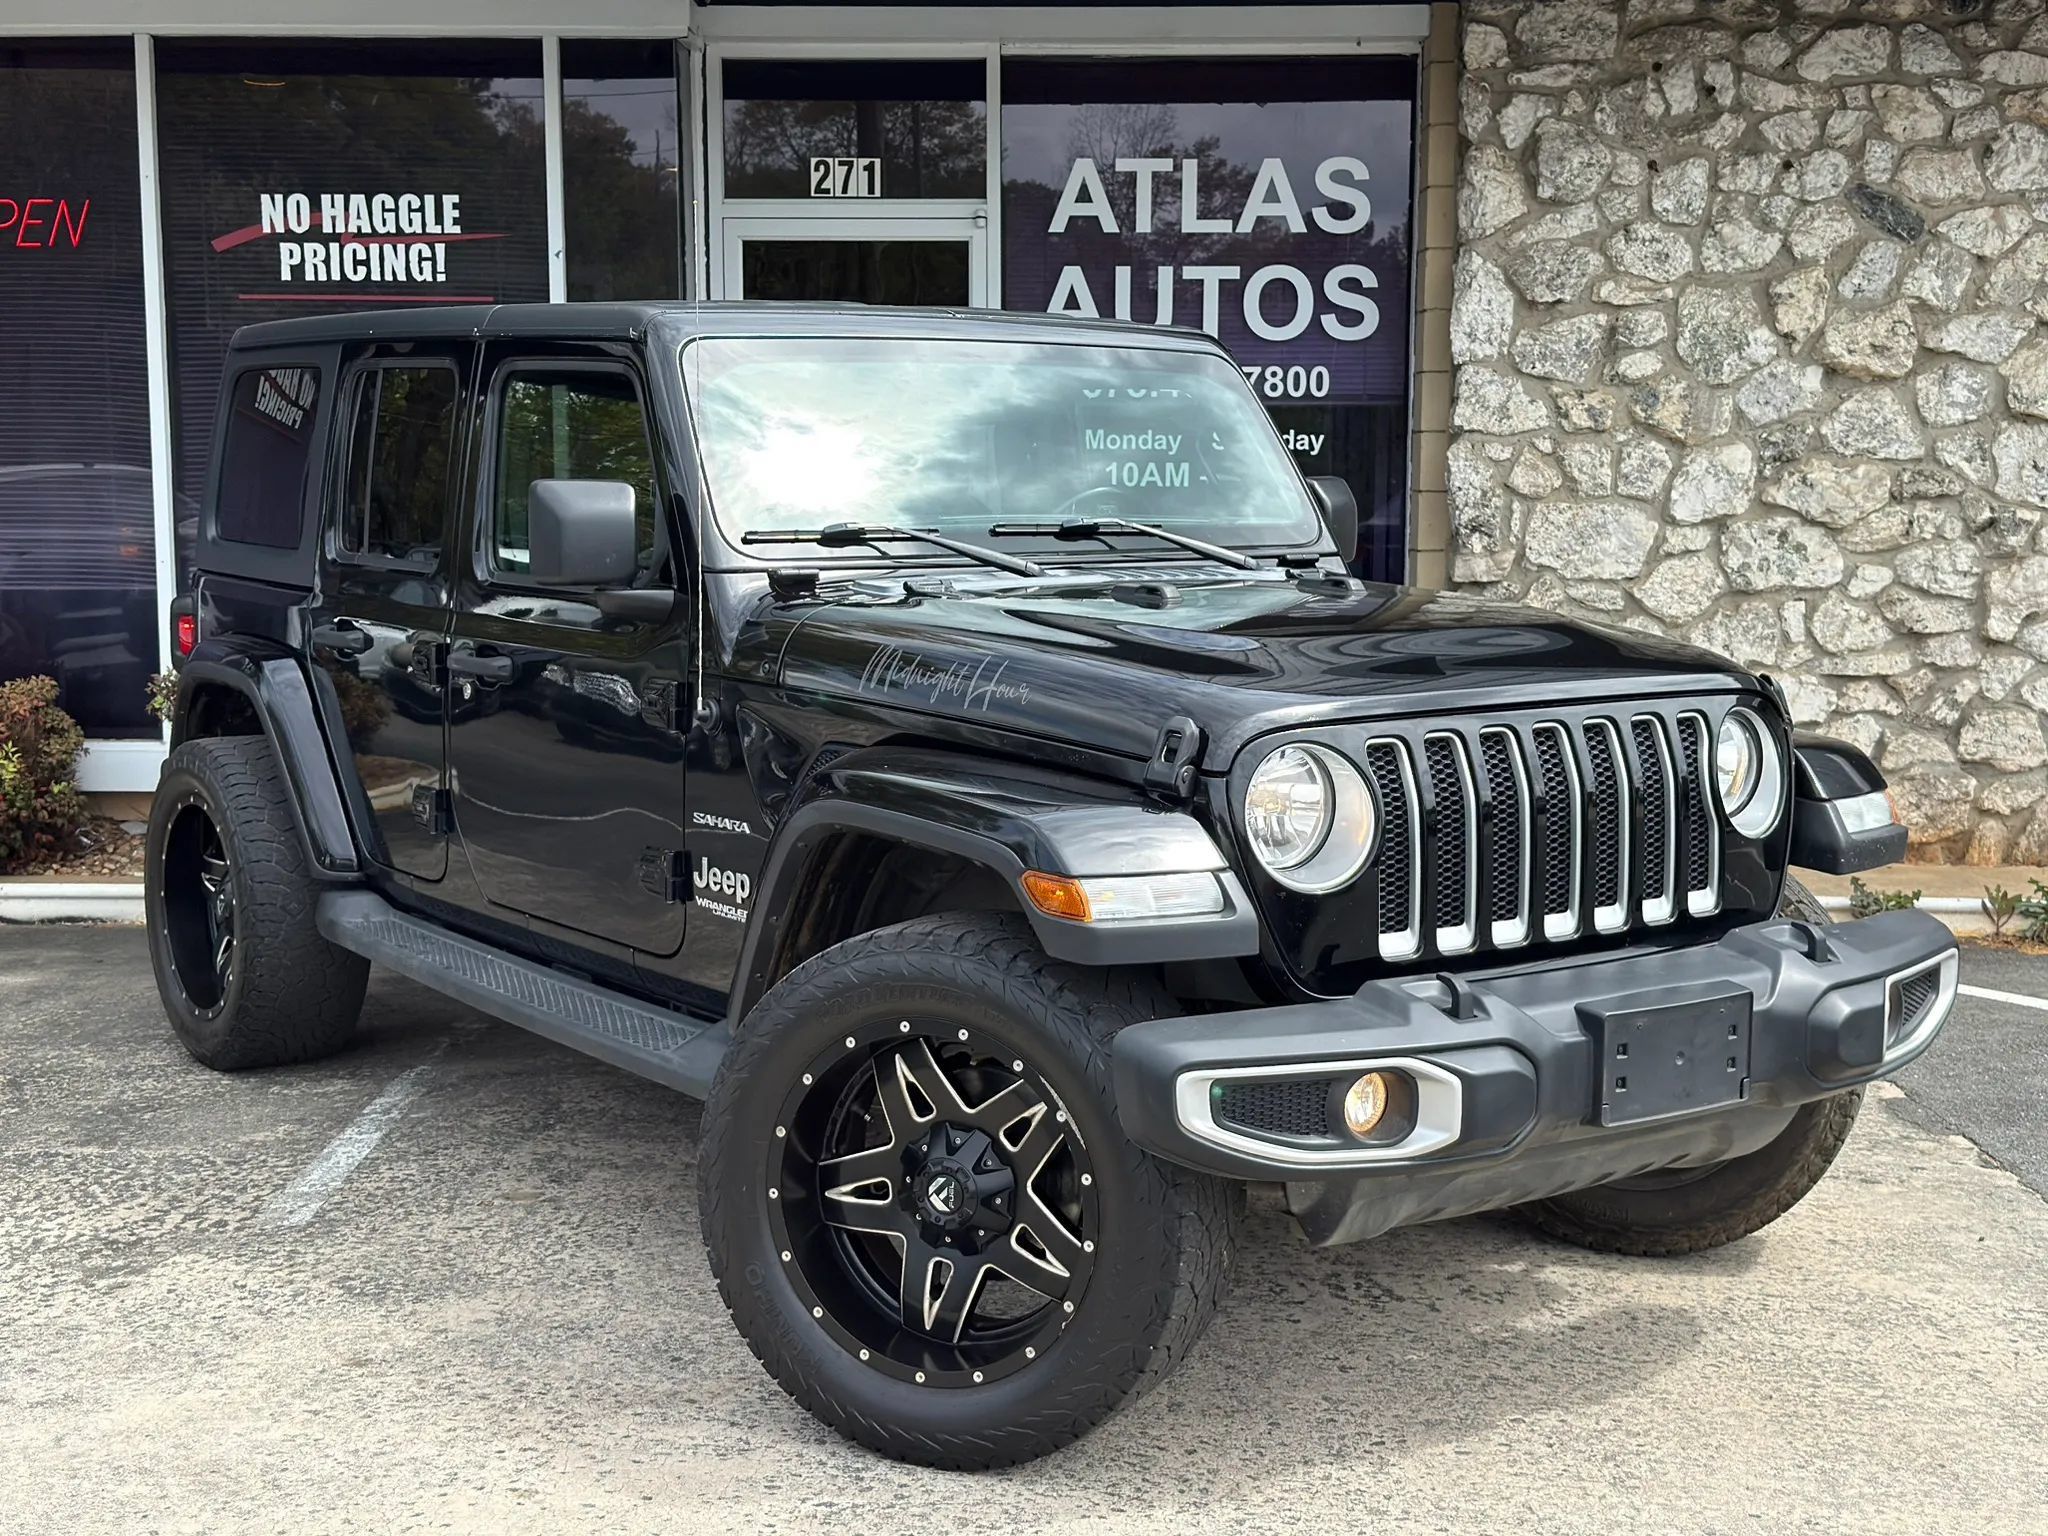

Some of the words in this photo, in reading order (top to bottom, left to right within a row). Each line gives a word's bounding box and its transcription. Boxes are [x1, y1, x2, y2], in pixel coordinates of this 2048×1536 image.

[813, 158, 876, 195] 271
[1048, 156, 1371, 235] ATLAS
[260, 193, 311, 234] NO
[320, 193, 462, 234] HAGGLE
[279, 242, 447, 282] PRICING!
[1046, 264, 1380, 341] AUTOS
[1085, 428, 1182, 455] Monday
[1105, 461, 1190, 488] 10AM
[858, 643, 970, 704] Midnight
[963, 654, 1032, 712] Hour
[692, 811, 751, 834] SAHARA
[693, 856, 750, 904] Jeep
